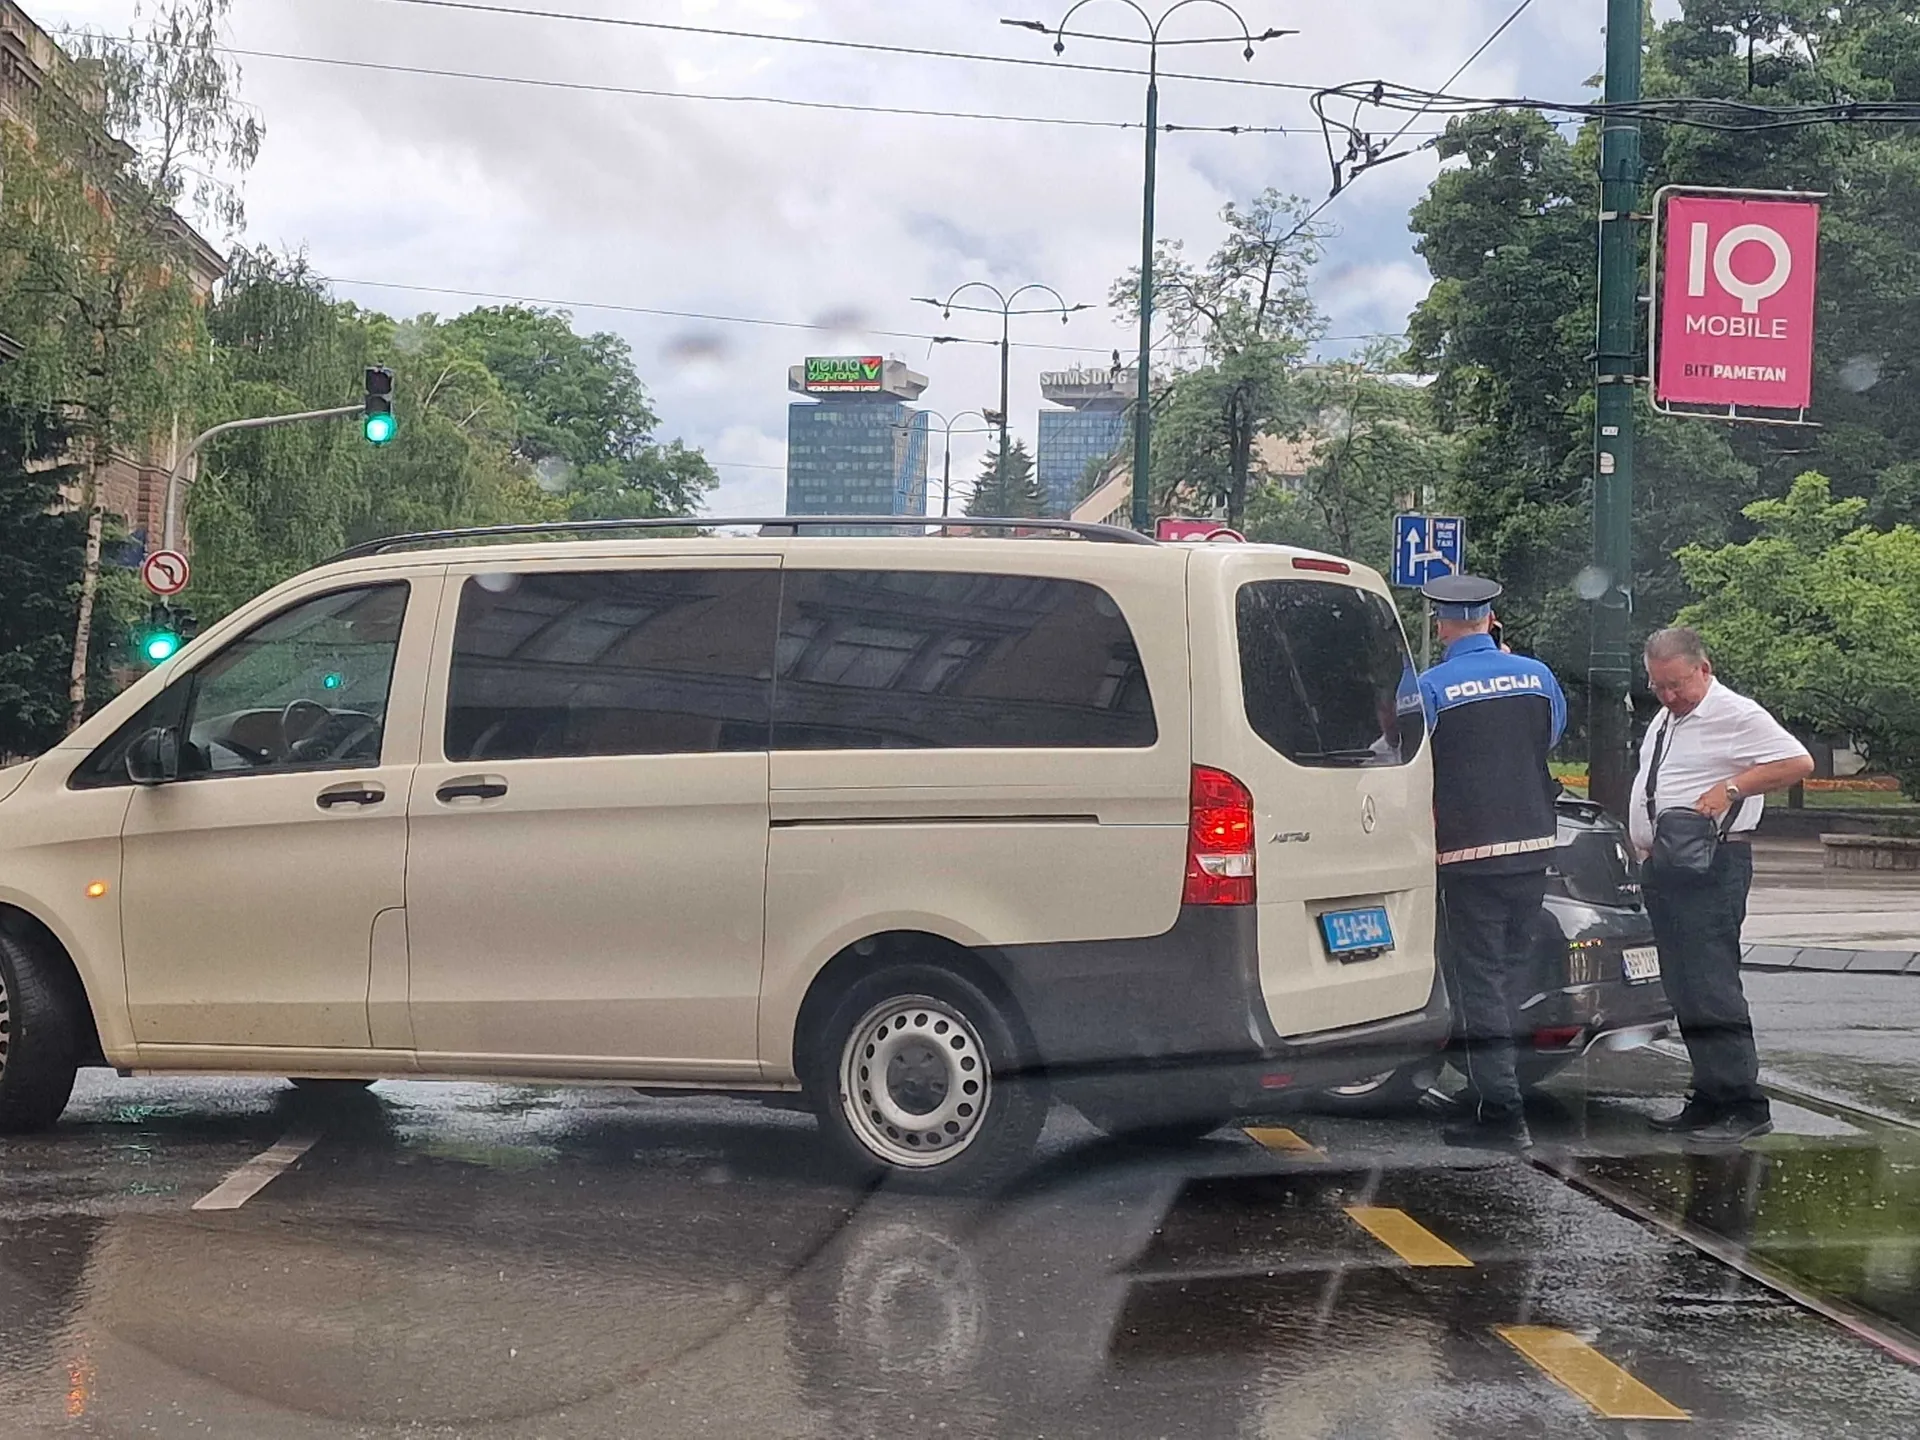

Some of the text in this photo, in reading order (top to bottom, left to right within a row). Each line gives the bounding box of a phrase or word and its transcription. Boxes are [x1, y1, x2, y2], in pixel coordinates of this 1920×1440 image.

[1687, 222, 1792, 314] IQ
[1685, 314, 1789, 339] MOBILE
[1041, 369, 1128, 386] SAMSUNG
[1445, 674, 1543, 701] POLICIJA
